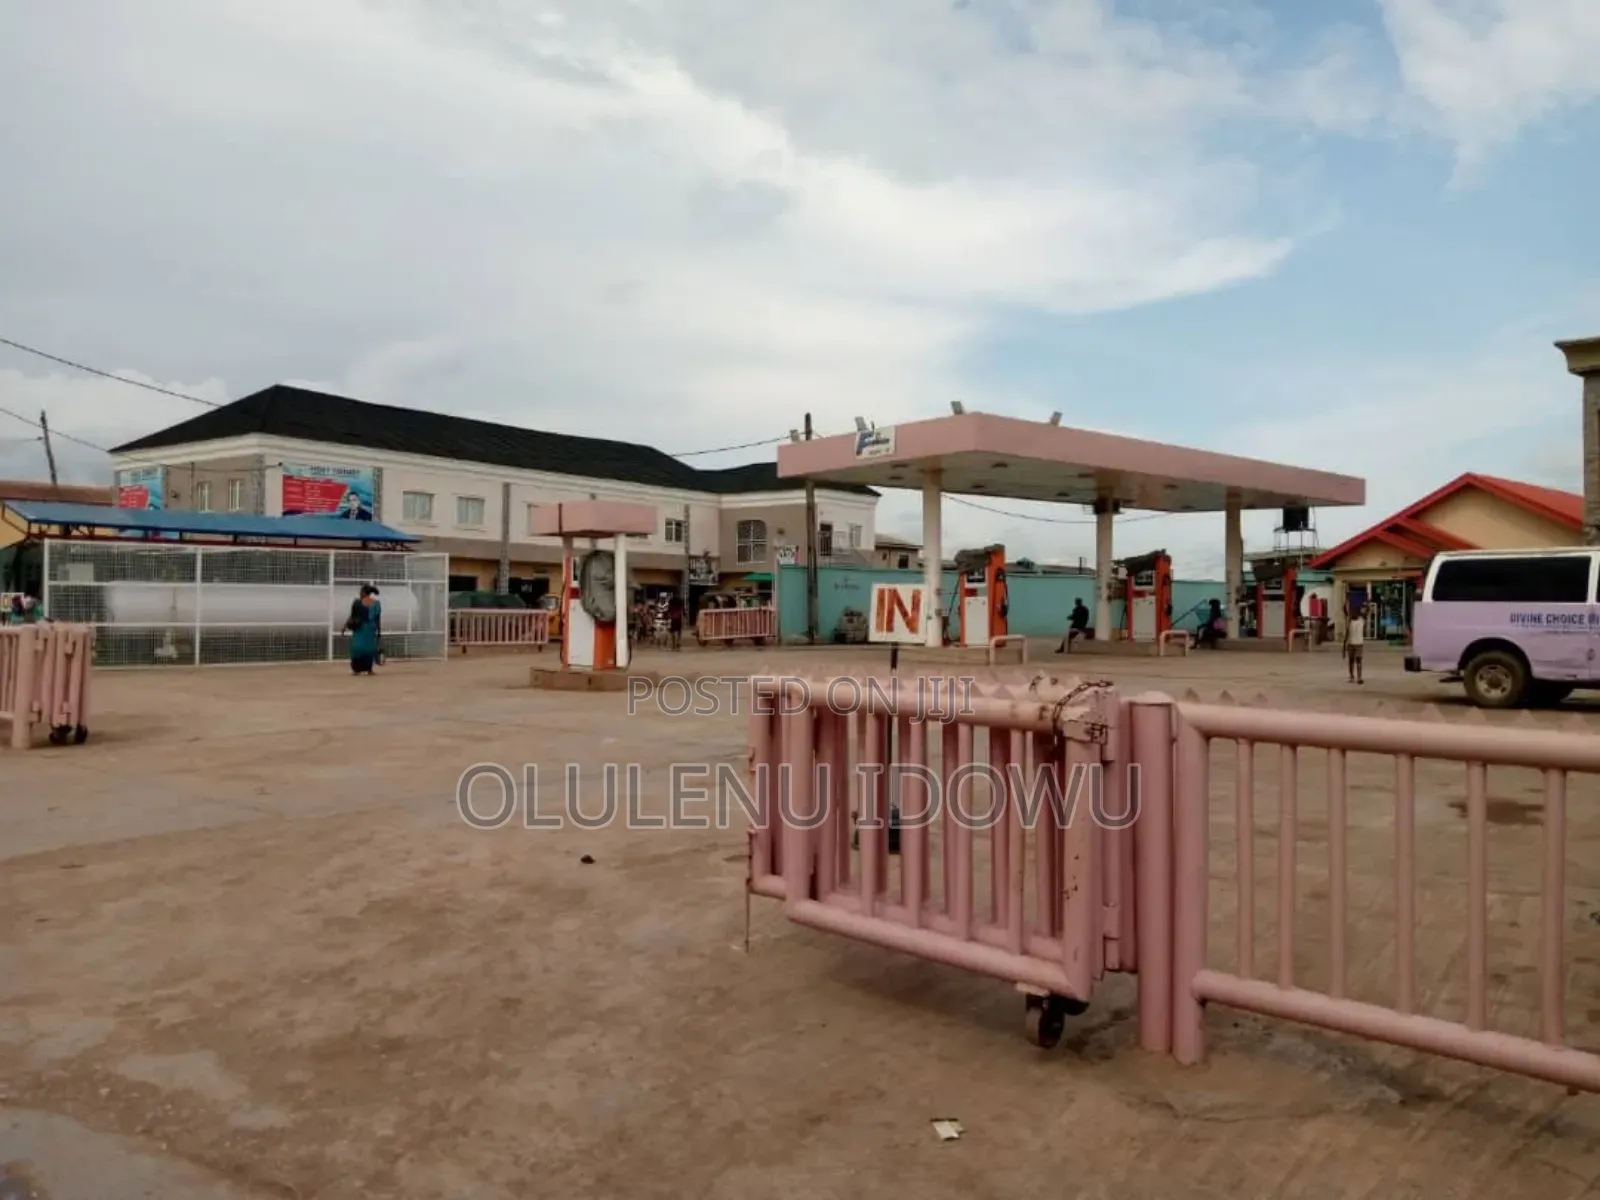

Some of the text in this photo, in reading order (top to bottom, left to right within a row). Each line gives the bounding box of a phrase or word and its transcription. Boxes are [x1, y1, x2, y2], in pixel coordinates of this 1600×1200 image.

[875, 587, 922, 634] IN
[1510, 612, 1543, 624] DIVINE
[1546, 613, 1585, 625] CHOICE
